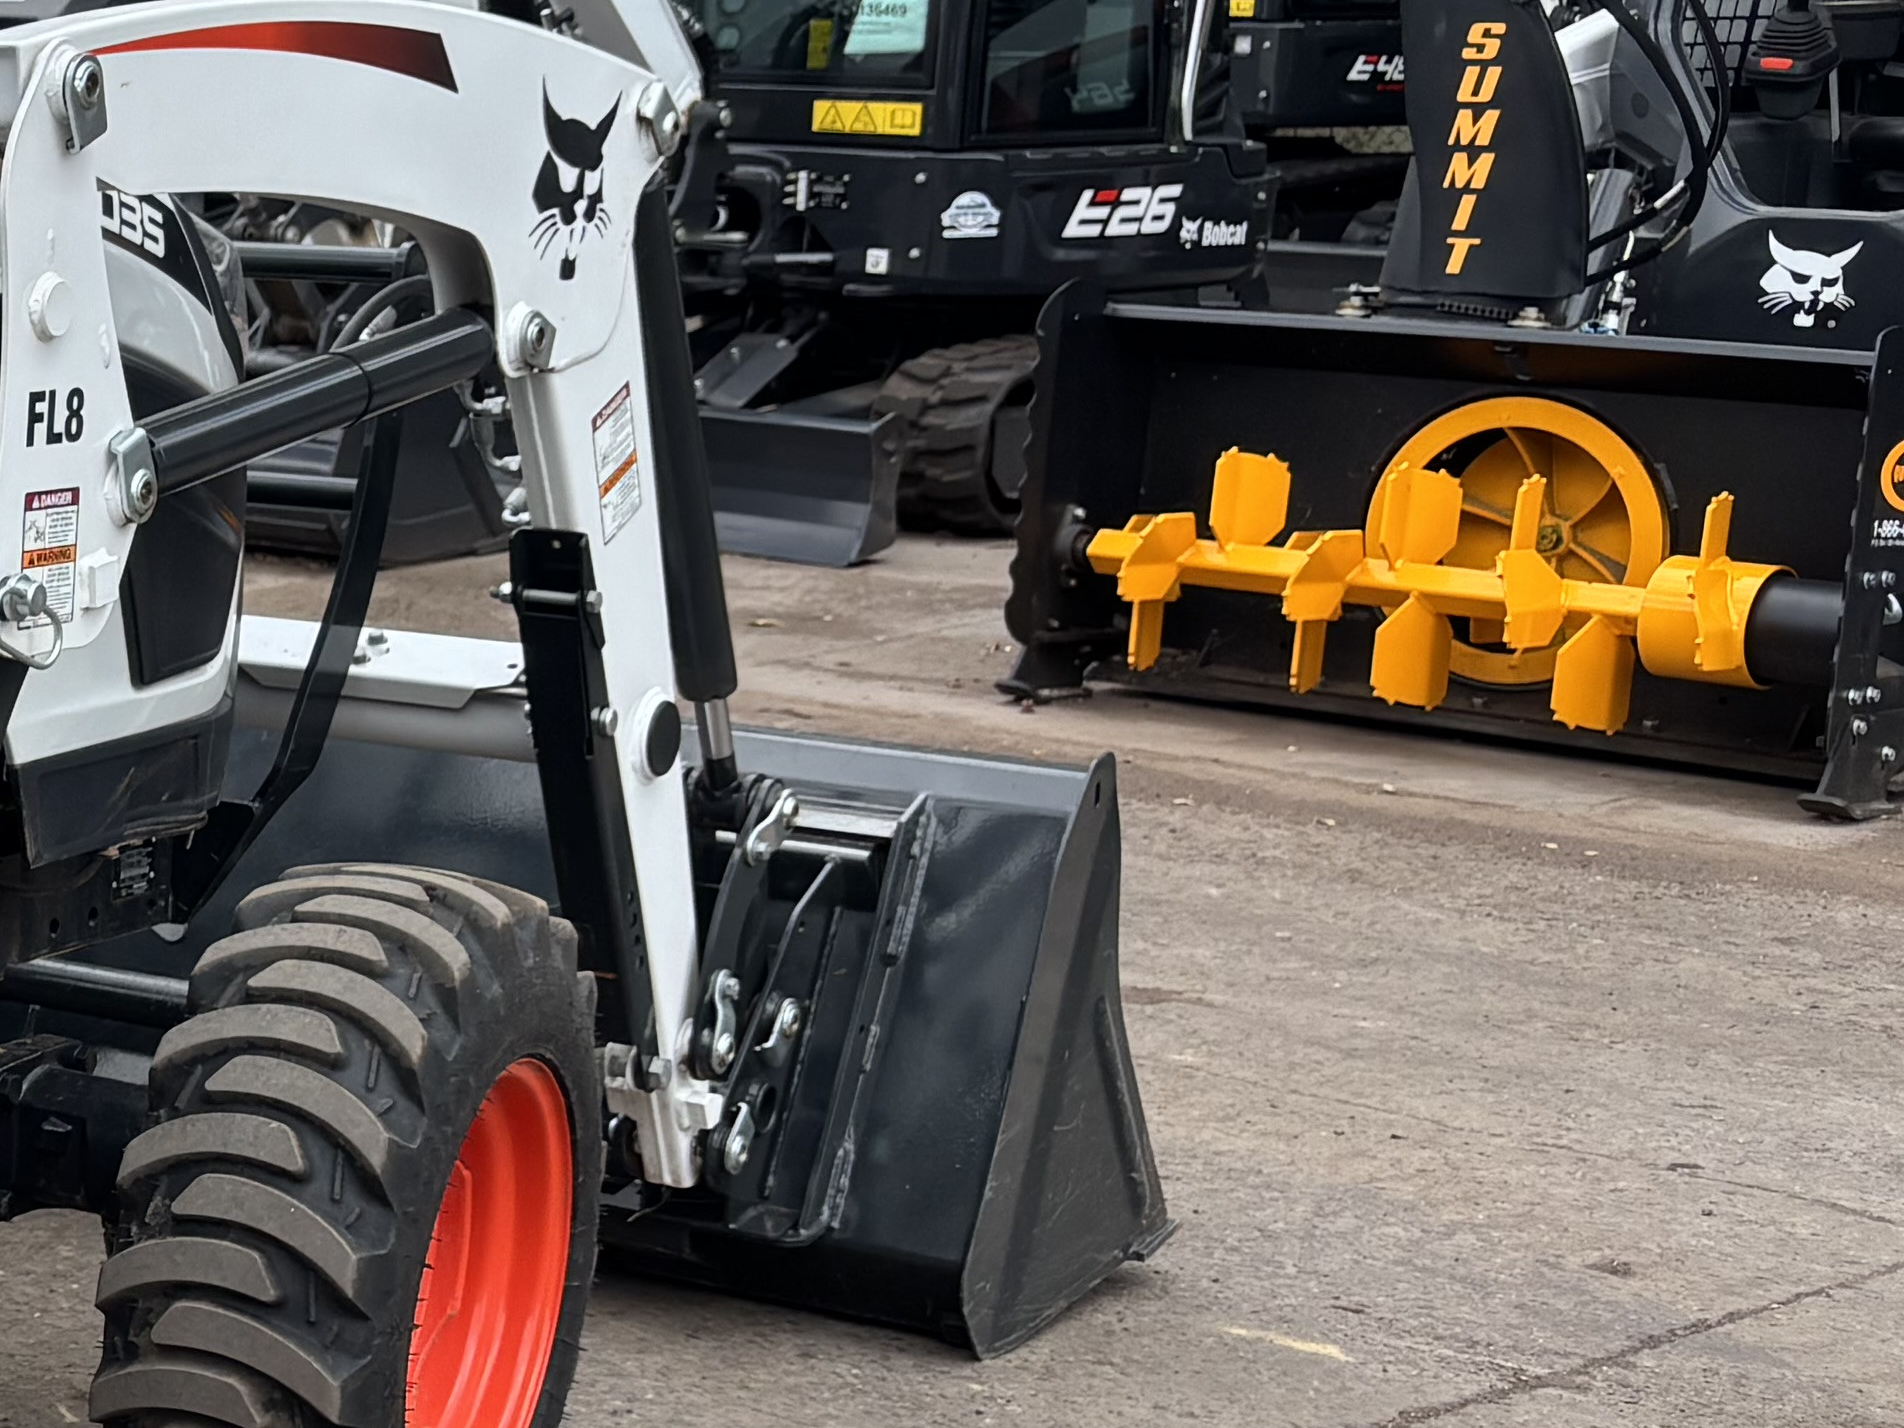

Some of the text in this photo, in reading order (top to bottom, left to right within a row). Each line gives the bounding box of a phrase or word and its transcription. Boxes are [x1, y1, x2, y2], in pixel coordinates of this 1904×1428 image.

[1442, 22, 1507, 276] SUMMIT
[1061, 183, 1248, 247] E26 Bobcat
[26, 387, 85, 448] FL8
